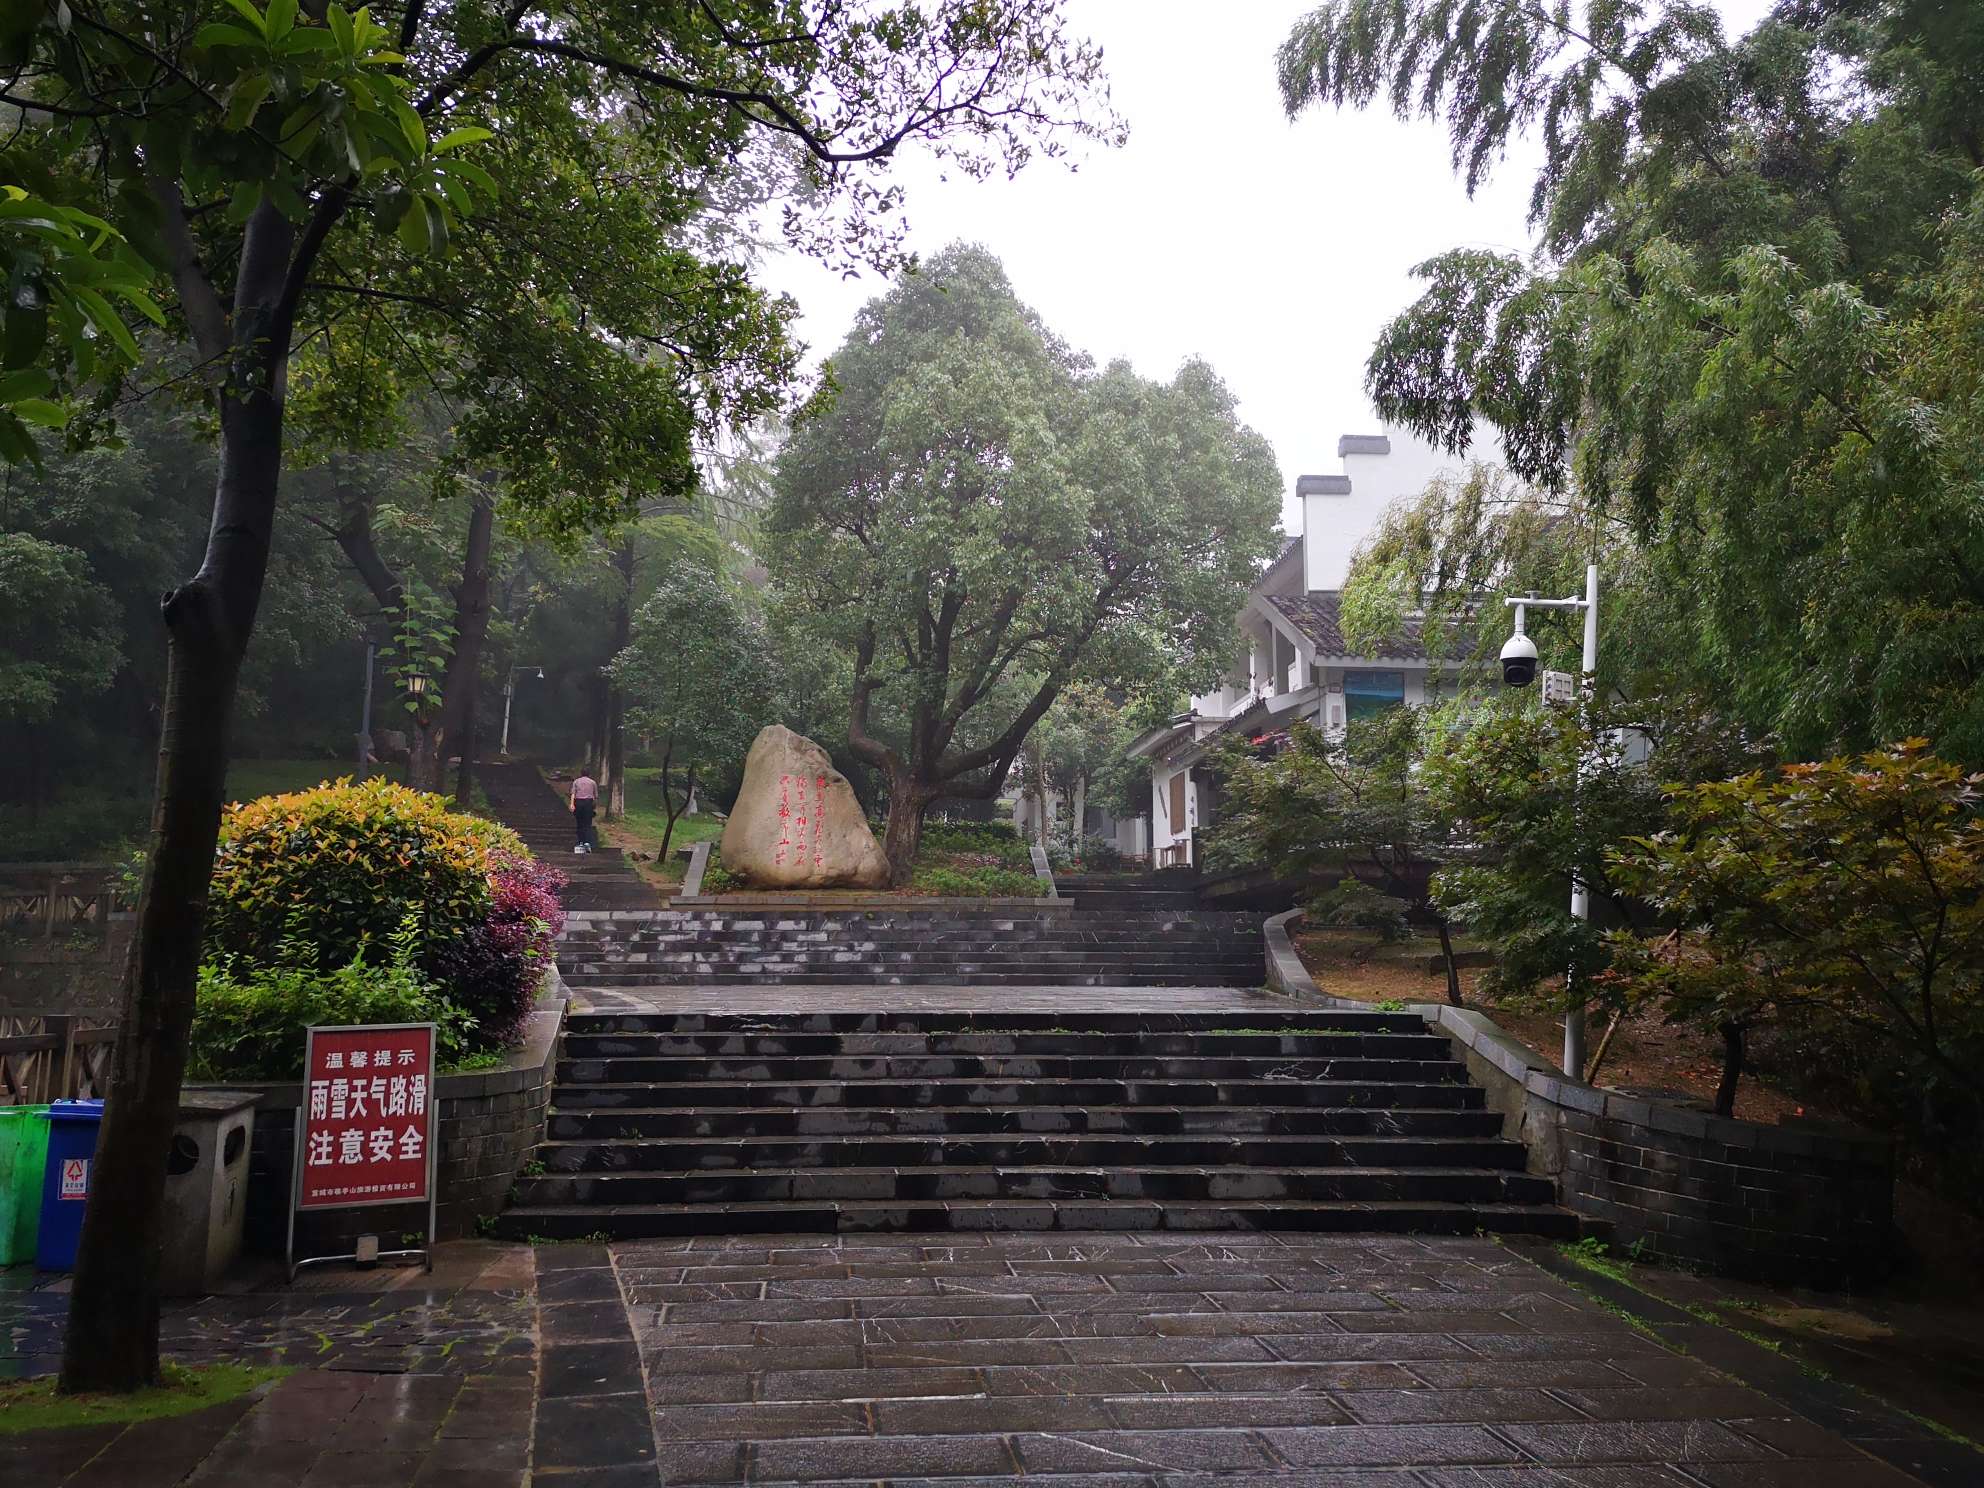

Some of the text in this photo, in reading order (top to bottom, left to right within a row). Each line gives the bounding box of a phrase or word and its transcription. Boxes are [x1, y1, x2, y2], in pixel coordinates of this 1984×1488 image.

[325, 1049, 416, 1069] 温馨提示
[310, 1074, 427, 1121] 雨雪天气路滑
[308, 1125, 424, 1167] 注意安全
